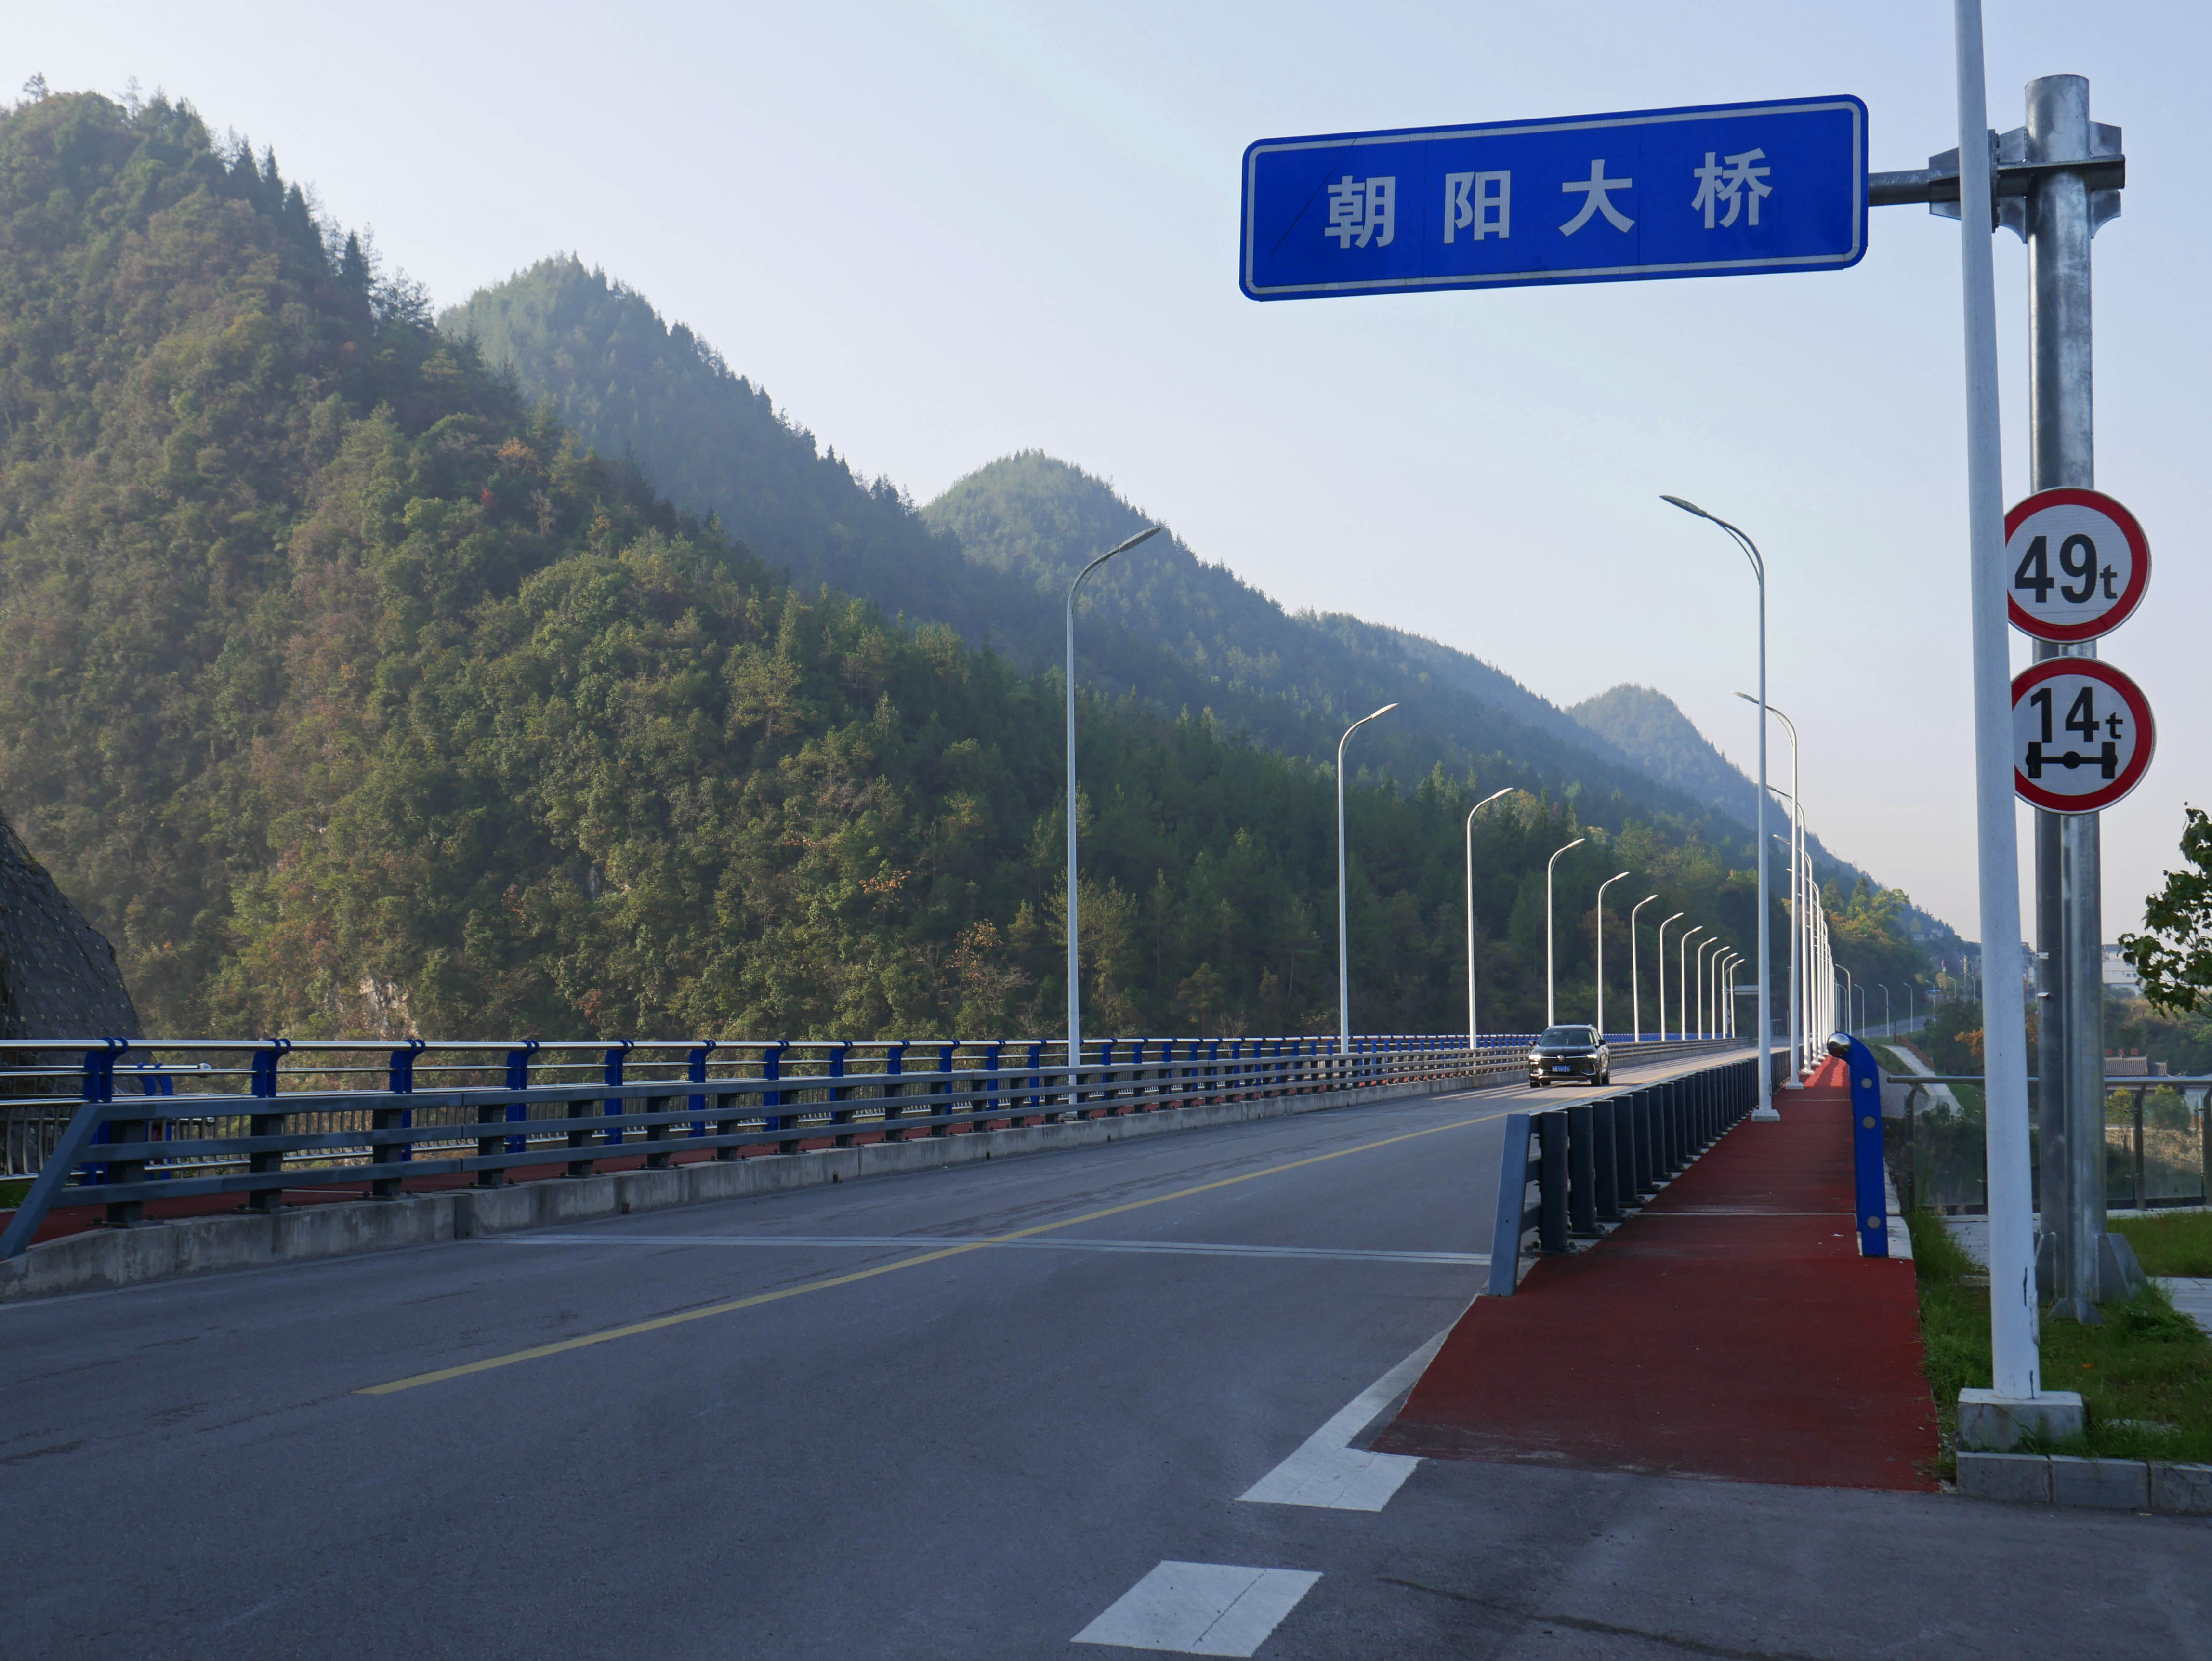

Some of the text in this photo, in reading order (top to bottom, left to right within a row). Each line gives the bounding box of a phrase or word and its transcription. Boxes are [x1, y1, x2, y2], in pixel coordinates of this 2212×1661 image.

[1325, 148, 1772, 248] 朝阳大桥
[2014, 533, 2118, 603] 49t
[2030, 686, 2124, 743] 14t
